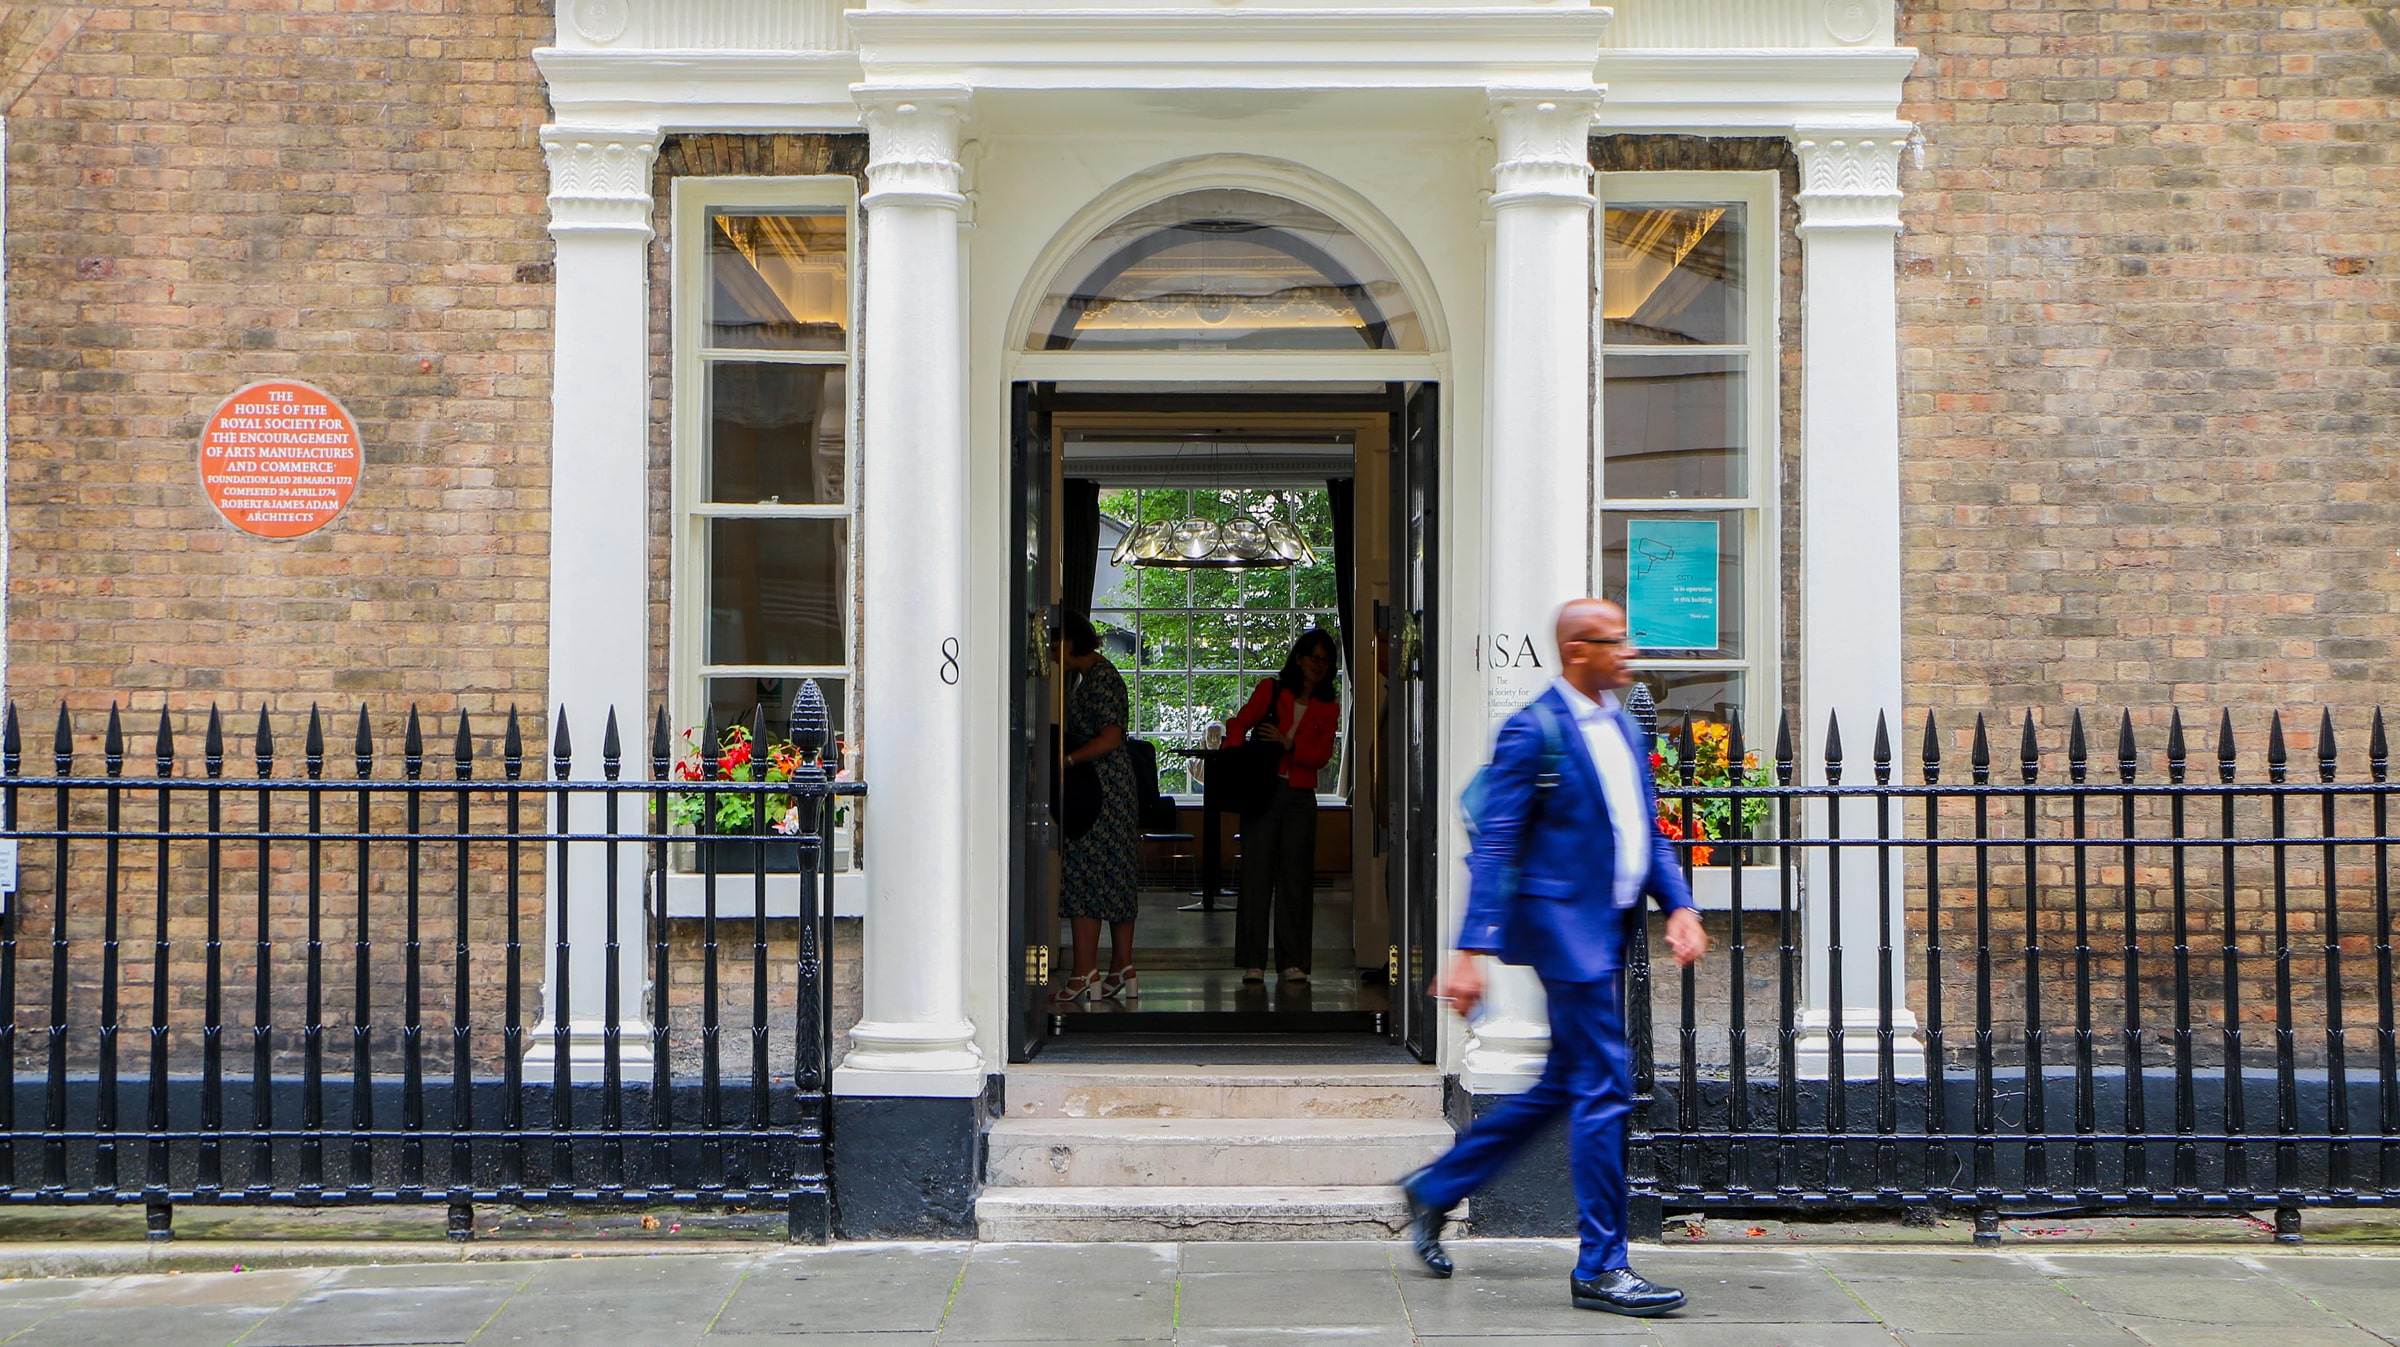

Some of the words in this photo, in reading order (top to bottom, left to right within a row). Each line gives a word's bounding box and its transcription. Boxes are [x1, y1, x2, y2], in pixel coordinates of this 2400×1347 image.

[268, 391, 294, 402] THE
[235, 403, 280, 415] HOUSE
[282, 404, 300, 415] OF
[302, 404, 327, 416] THE
[220, 417, 263, 429] ROYAL
[264, 418, 317, 430] SOCIETY
[319, 418, 344, 430] FOR
[211, 432, 237, 443] THE
[239, 432, 349, 444] ENCOURAGEMENT
[206, 447, 223, 457] OF
[224, 447, 256, 458] ARTS
[258, 447, 354, 459] MANUFACTURES
[226, 461, 257, 472] AND
[207, 475, 268, 484] FOUNDATION
[269, 475, 291, 485] LAID
[292, 476, 303, 485] 28
[303, 476, 336, 485] MARCH
[336, 476, 353, 485] 1772
[223, 487, 277, 496] COMPLETED
[279, 488, 290, 497] 24
[291, 488, 317, 497] APRIL
[318, 488, 337, 497] 1774
[221, 499, 263, 509] ROBERT
[305, 500, 339, 510] ADAM
[246, 512, 314, 522] ARCHITECTS
[1691, 596, 1712, 604] building
[940, 637, 959, 685] 8
[1496, 676, 1508, 685] The
[1495, 687, 1516, 698] Society
[1518, 687, 1530, 696] for
